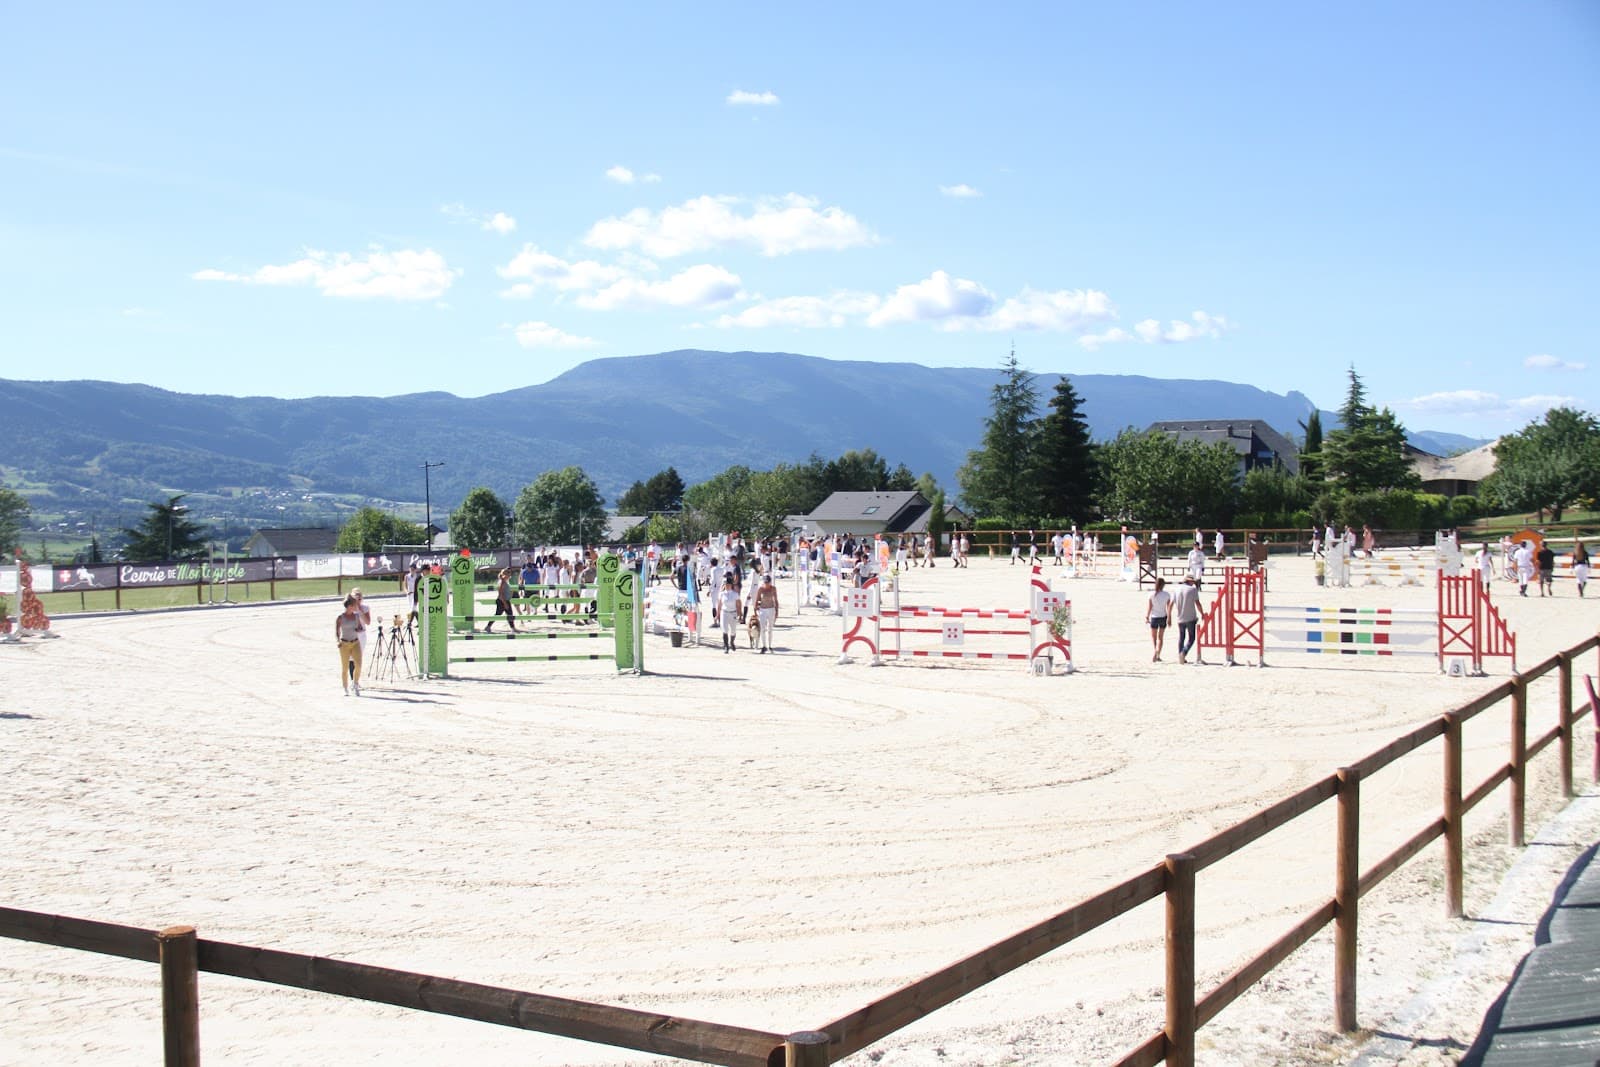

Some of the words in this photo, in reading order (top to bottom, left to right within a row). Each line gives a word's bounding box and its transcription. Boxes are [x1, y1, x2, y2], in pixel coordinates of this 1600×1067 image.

[120, 564, 167, 583] Ecurie
[168, 569, 176, 579] DE
[619, 602, 633, 611] ED
[1452, 663, 1460, 674] 3
